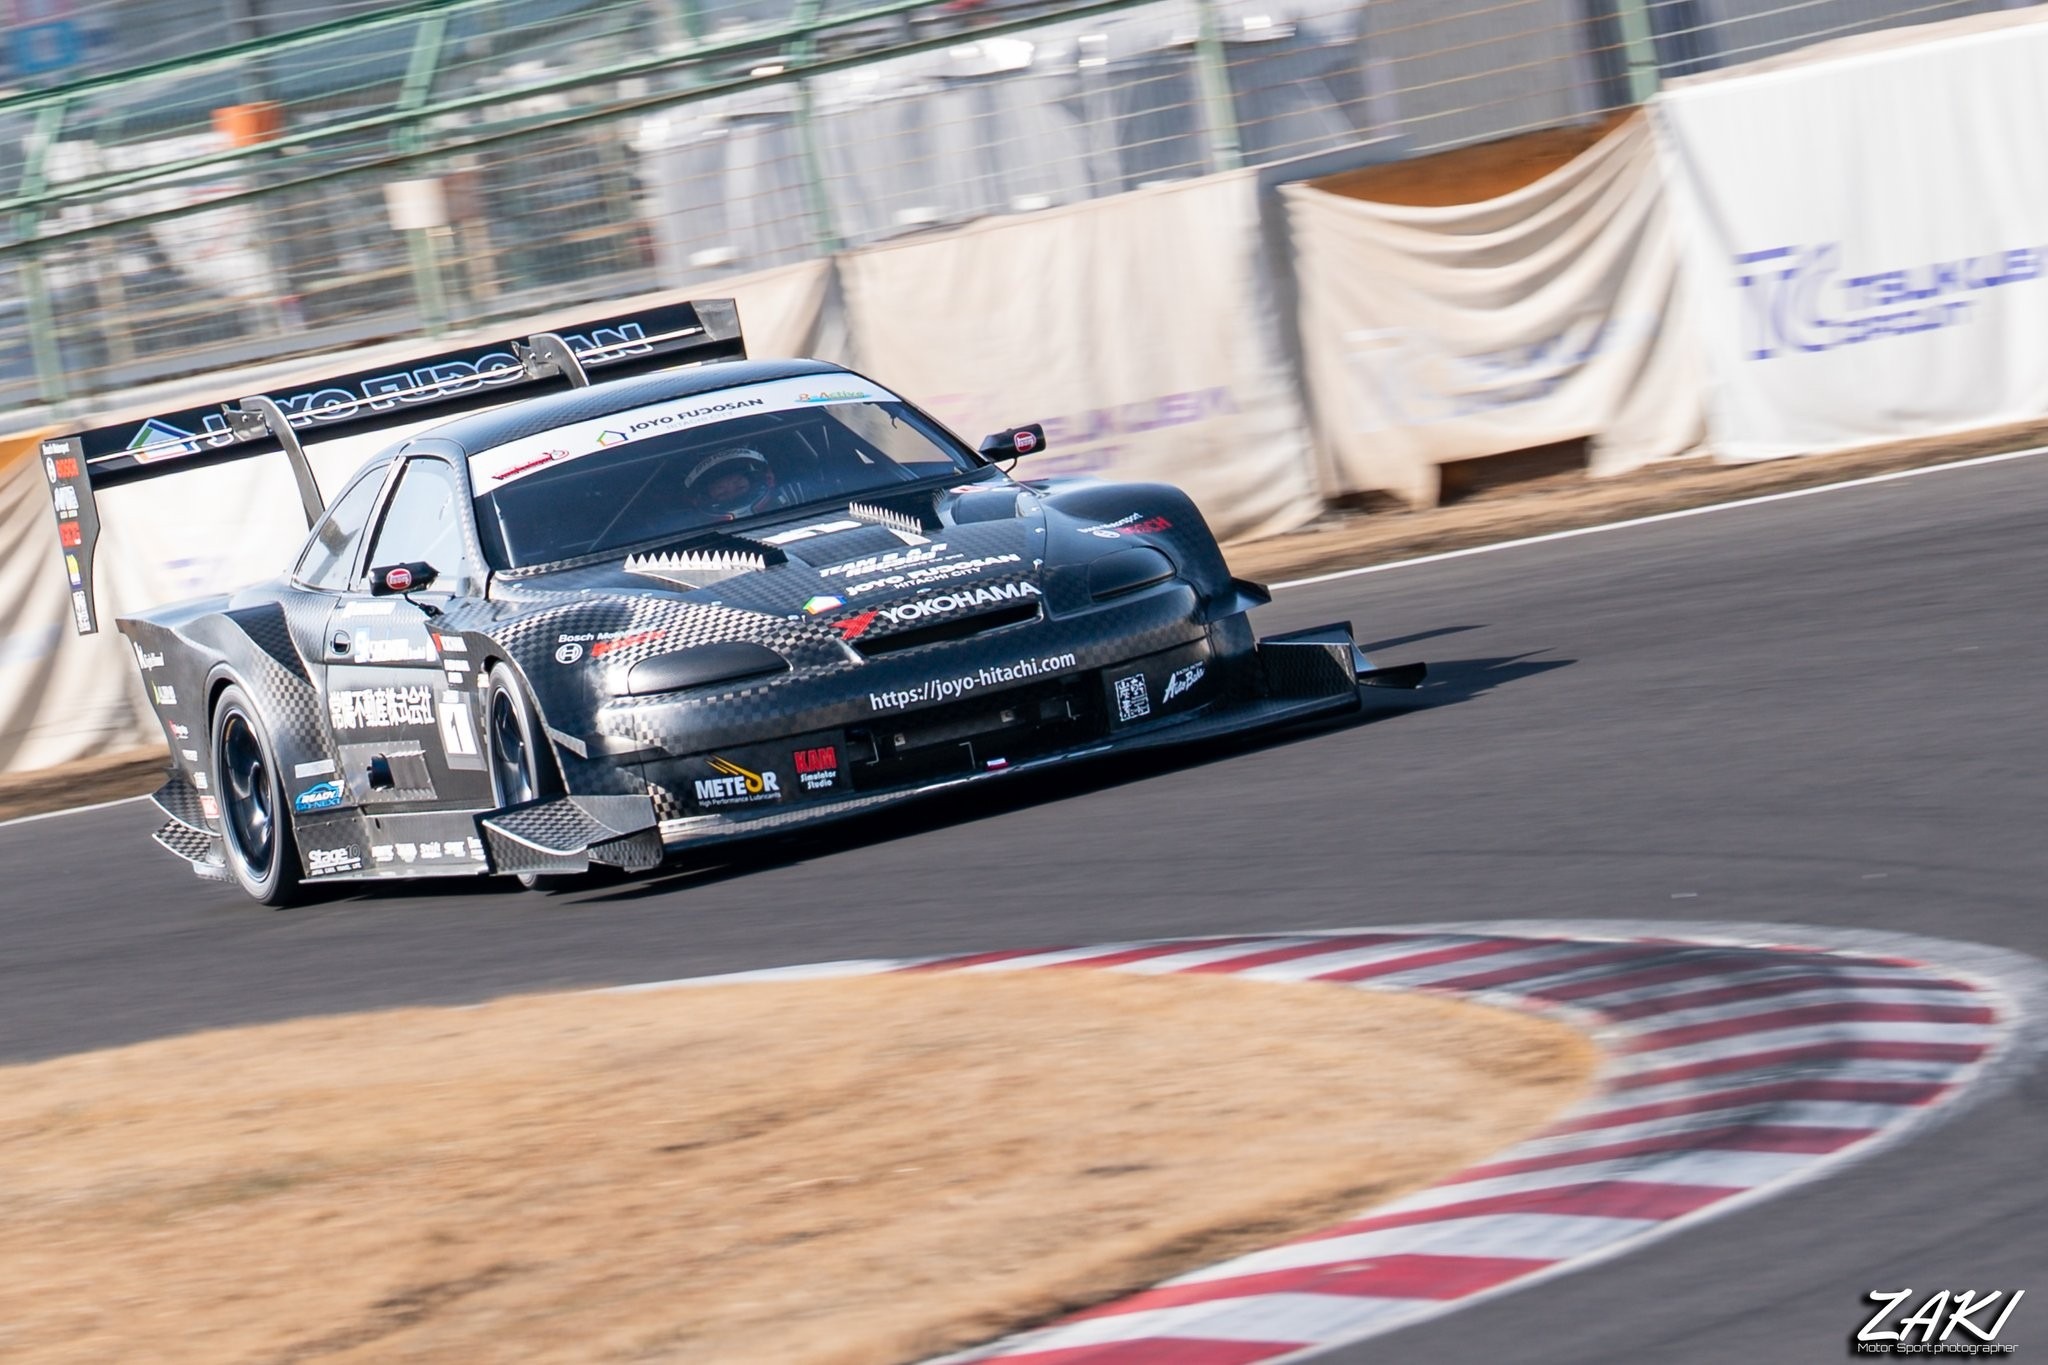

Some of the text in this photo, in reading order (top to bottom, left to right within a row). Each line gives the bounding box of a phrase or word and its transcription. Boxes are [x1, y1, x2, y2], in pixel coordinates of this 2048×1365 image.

[202, 323, 653, 447] JYO FUDOAN
[629, 398, 763, 433] JOYO FUDOSAN
[846, 575, 906, 596] JOYO
[907, 553, 1021, 579] FUDOSAN
[893, 567, 982, 590] HITACHI CITY
[878, 581, 1043, 625] YOKOHAMA
[558, 632, 594, 643] Bosch
[869, 652, 1077, 712] https://joyo-hitachi.com
[794, 746, 837, 774] KAM
[800, 770, 837, 783] Simulator
[695, 756, 780, 800] METEOR
[807, 778, 833, 790] Studio
